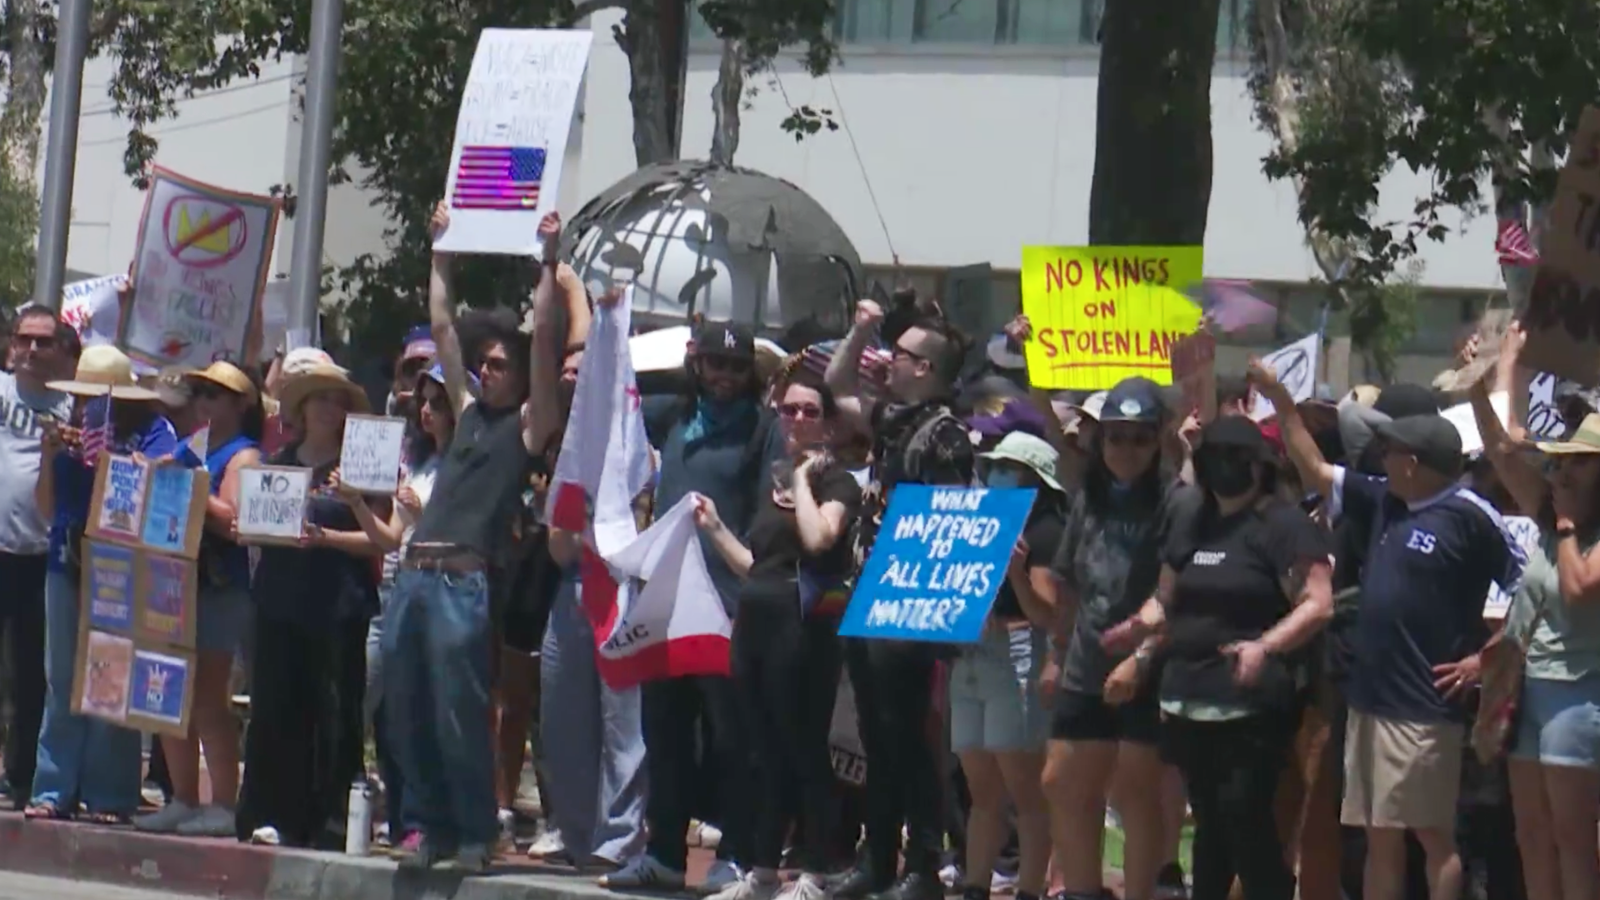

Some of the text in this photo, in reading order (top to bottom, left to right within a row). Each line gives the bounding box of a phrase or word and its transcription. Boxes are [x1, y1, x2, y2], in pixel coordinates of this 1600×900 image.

[1045, 256, 1170, 293] NO KINGS
[1083, 299, 1116, 319] ON
[1038, 327, 1182, 361] STOLEN LAN
[260, 472, 290, 494] NO
[930, 488, 990, 511] WHAT
[894, 512, 1001, 548] HAPPENED
[1407, 528, 1437, 554] ES
[927, 539, 953, 560] TO
[927, 561, 996, 598] LIVES
